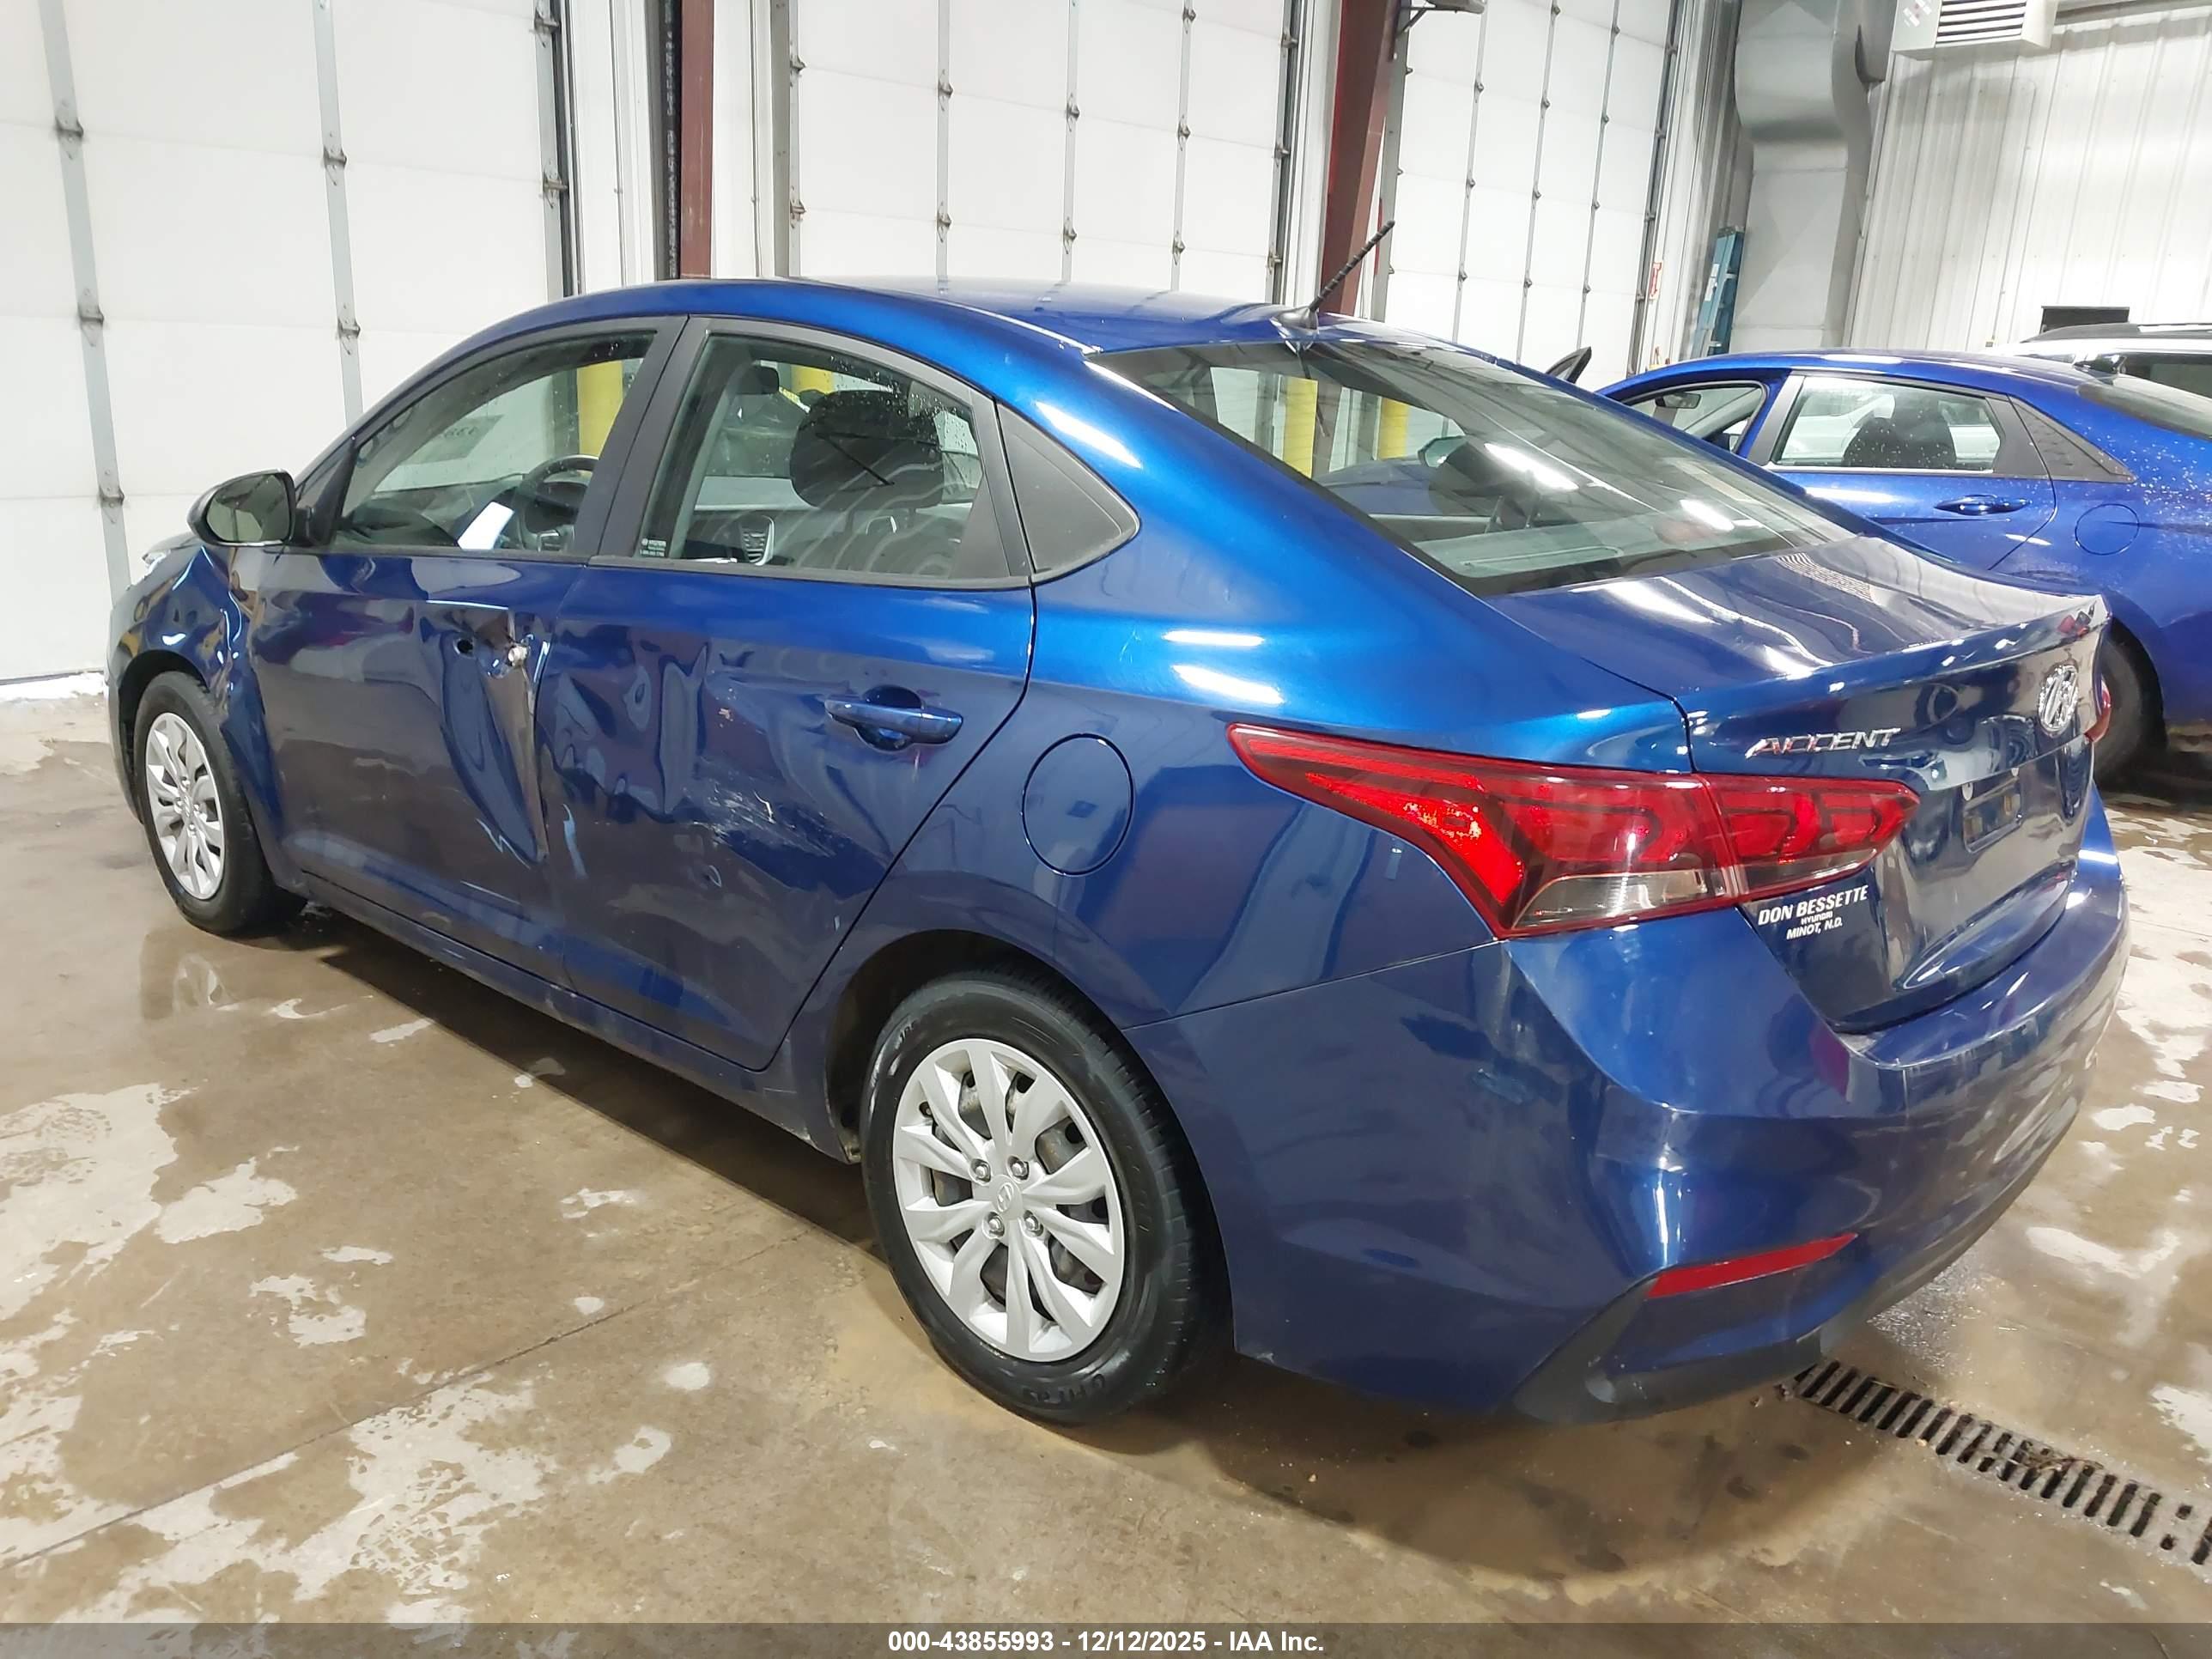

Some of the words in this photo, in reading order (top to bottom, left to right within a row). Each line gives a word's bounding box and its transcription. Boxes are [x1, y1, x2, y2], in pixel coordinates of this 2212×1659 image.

[1744, 727, 1902, 759] ACCENT
[1758, 903, 1794, 926] DON
[1796, 884, 1869, 918] BESSETTE
[1801, 910, 1833, 925] HYUNDAI
[1786, 922, 1821, 940] MINOT,
[1824, 916, 1843, 931] N.D.
